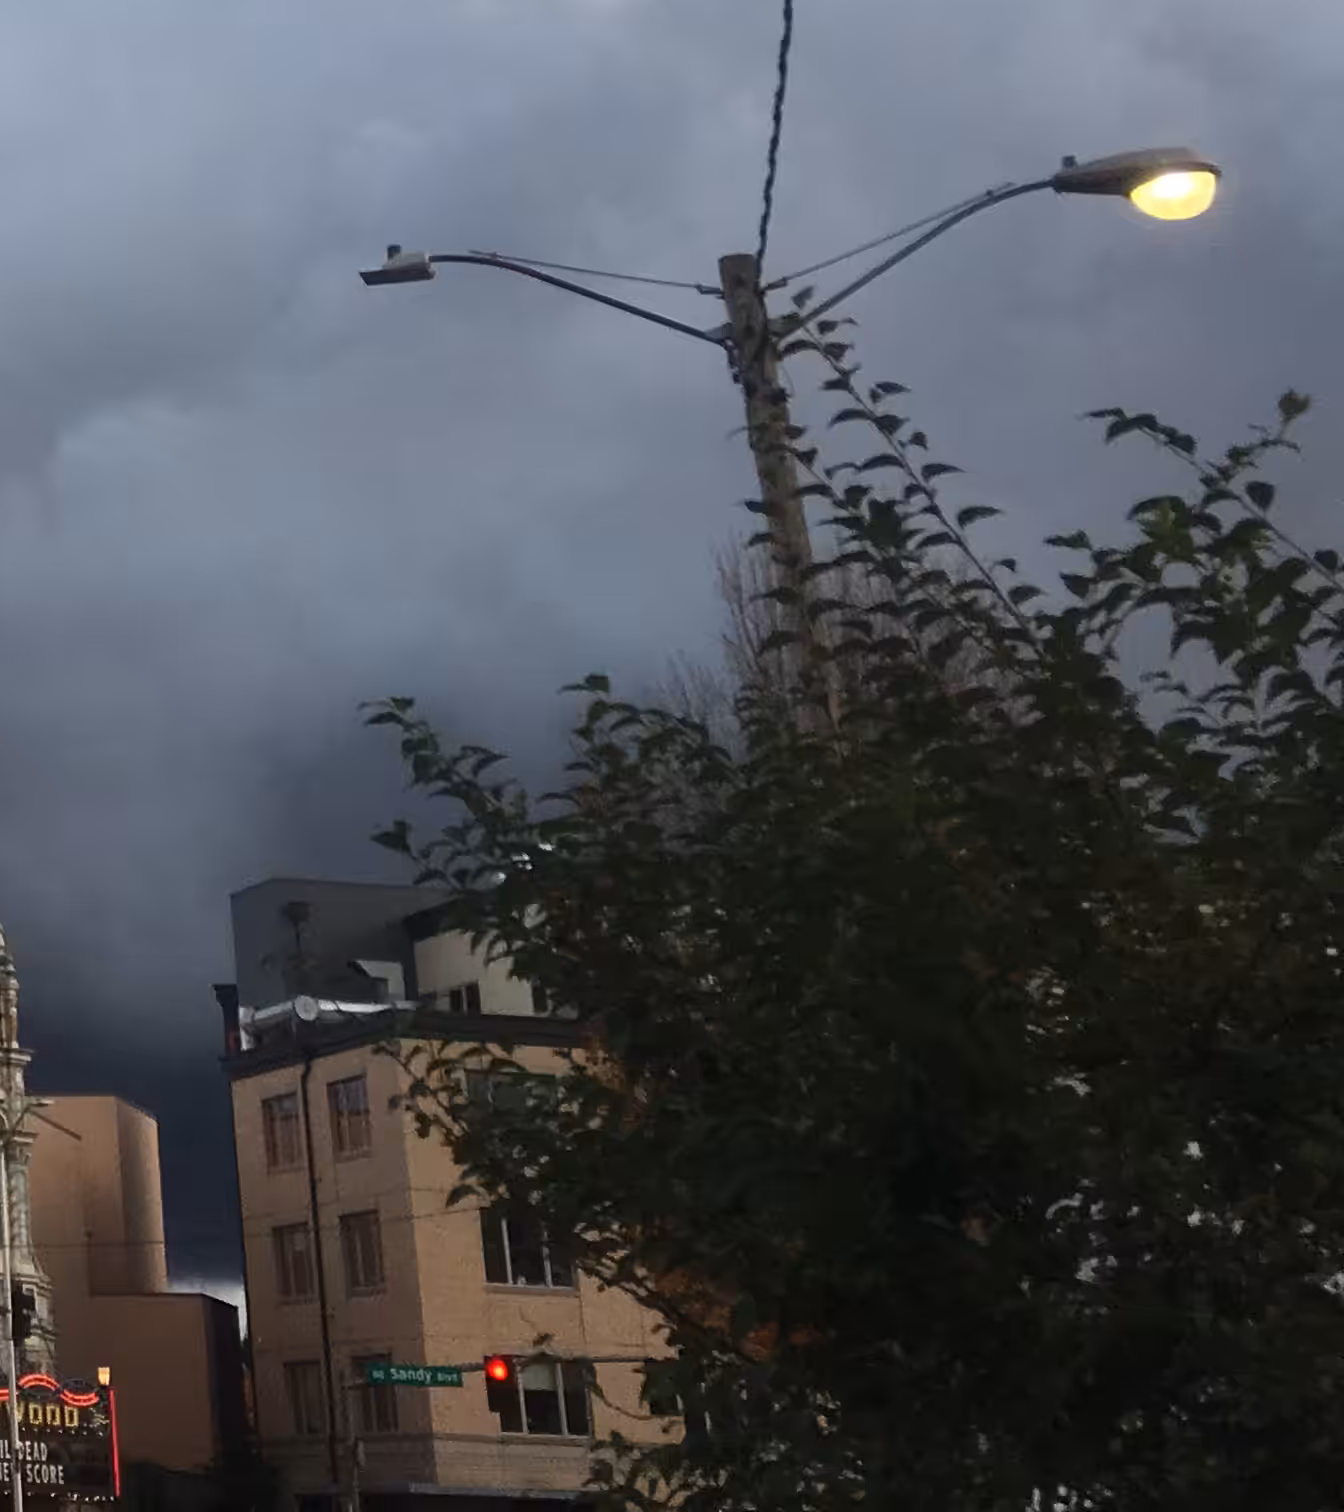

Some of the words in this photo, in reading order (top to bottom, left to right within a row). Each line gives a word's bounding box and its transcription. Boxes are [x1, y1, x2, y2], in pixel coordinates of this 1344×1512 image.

[390, 1368, 432, 1384] Sandy
[16, 1441, 48, 1462] DEAD
[25, 1463, 65, 1484] SCORE
